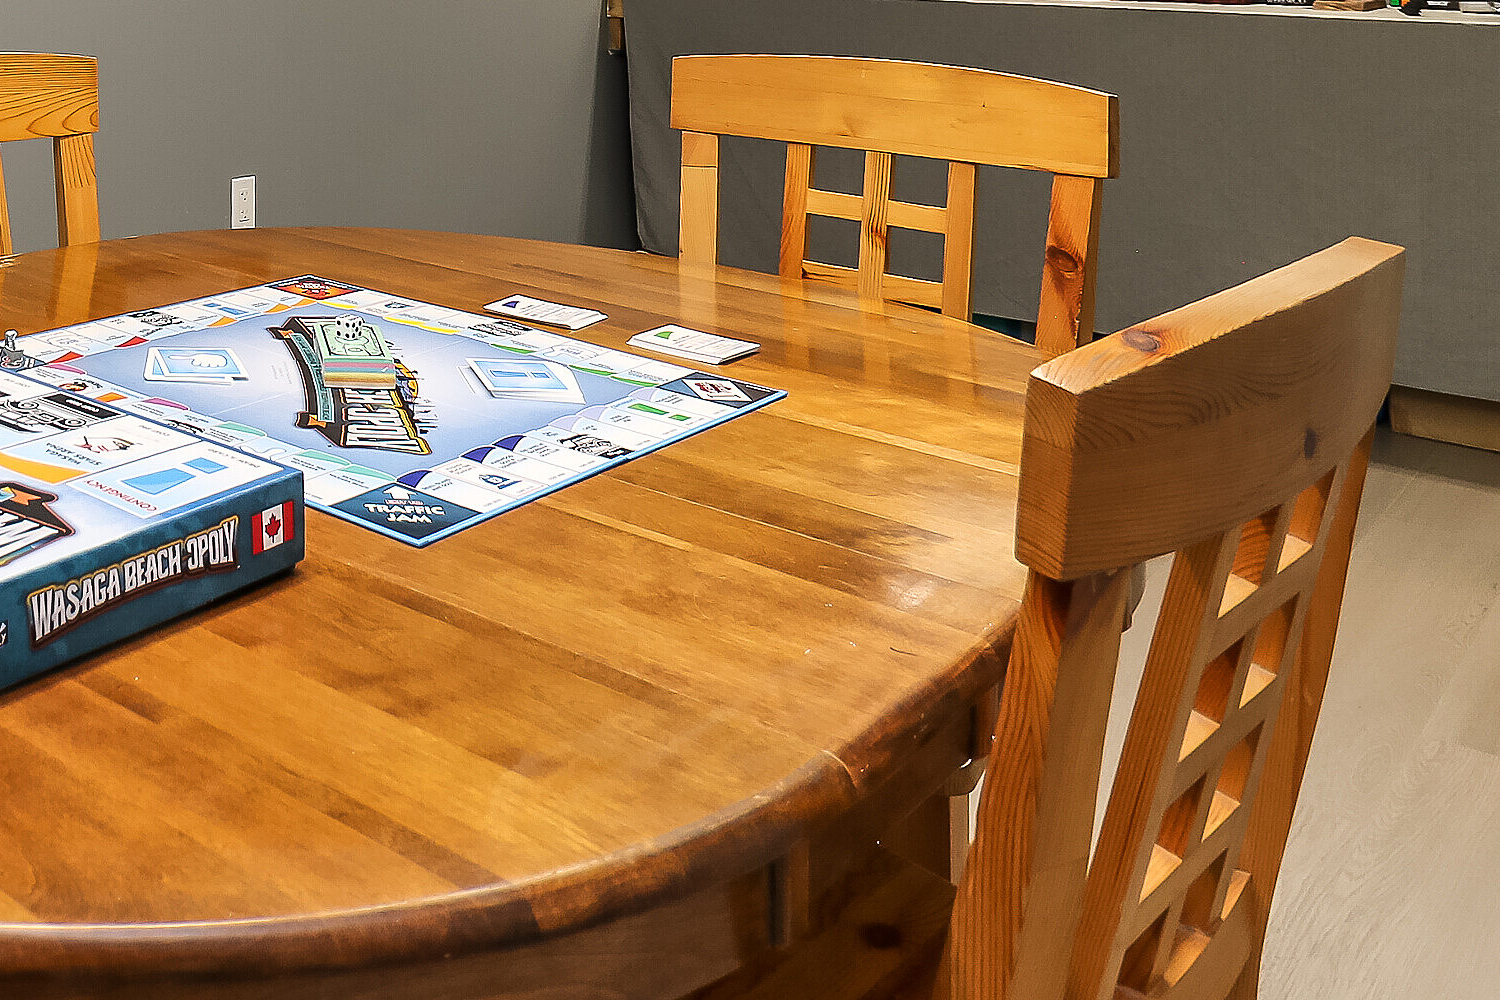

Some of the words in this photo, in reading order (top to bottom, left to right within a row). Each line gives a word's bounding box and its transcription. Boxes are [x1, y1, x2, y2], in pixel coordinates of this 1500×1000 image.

[84, 480, 157, 512] CONTINGENCY
[363, 502, 446, 516] TRAFFIC
[386, 512, 432, 524] JAM
[30, 570, 122, 642] WASAGA
[123, 542, 182, 592] BEACH
